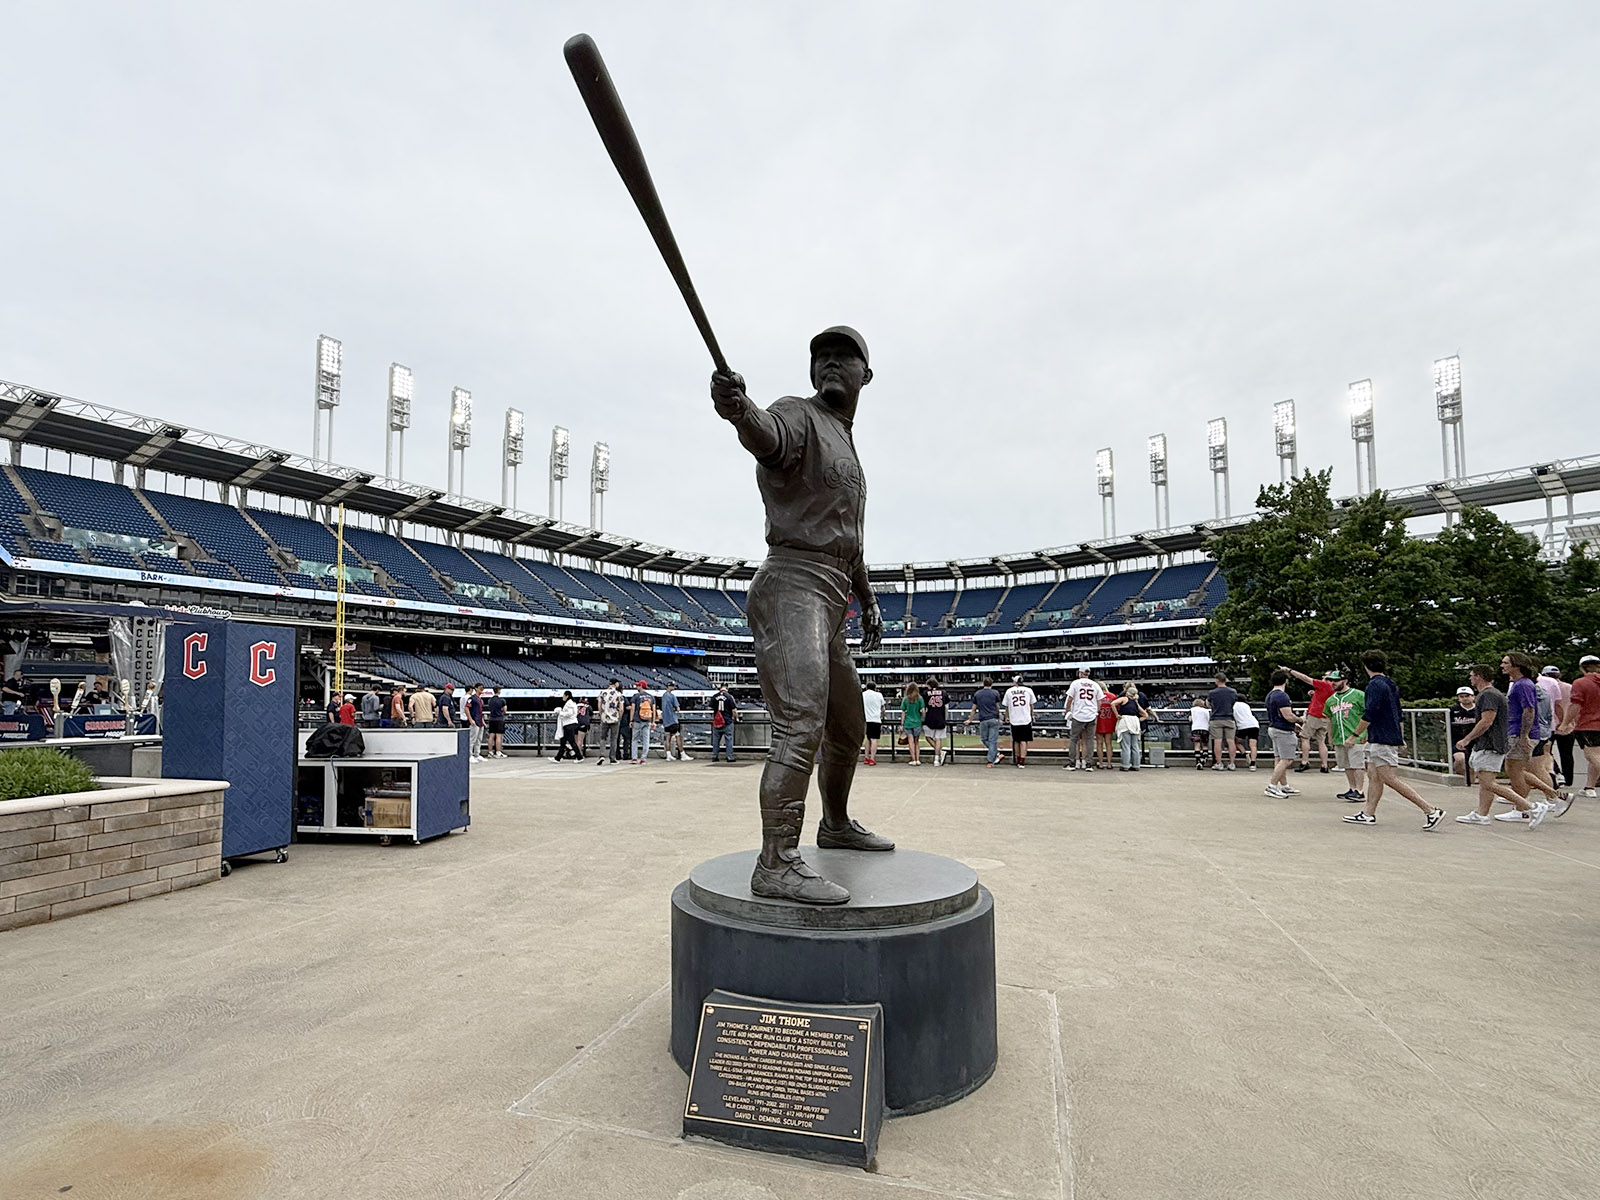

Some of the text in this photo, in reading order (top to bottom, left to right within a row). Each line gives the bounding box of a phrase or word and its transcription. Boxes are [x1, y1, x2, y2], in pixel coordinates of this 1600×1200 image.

[188, 606, 230, 616] Clubhouse
[183, 632, 208, 680] C
[249, 641, 276, 686] C
[1080, 688, 1094, 700] 25
[928, 696, 943, 708] 45
[1012, 696, 1026, 707] 25
[759, 1014, 811, 1028] JIM THOME
[726, 1022, 749, 1030] THOME'S
[750, 1025, 773, 1033] JOURNEY
[782, 1028, 804, 1036] BECOME
[810, 1031, 834, 1039] MEMBER
[722, 1095, 750, 1103] CLEVELAND
[783, 1118, 813, 1128] SCULPTOR
